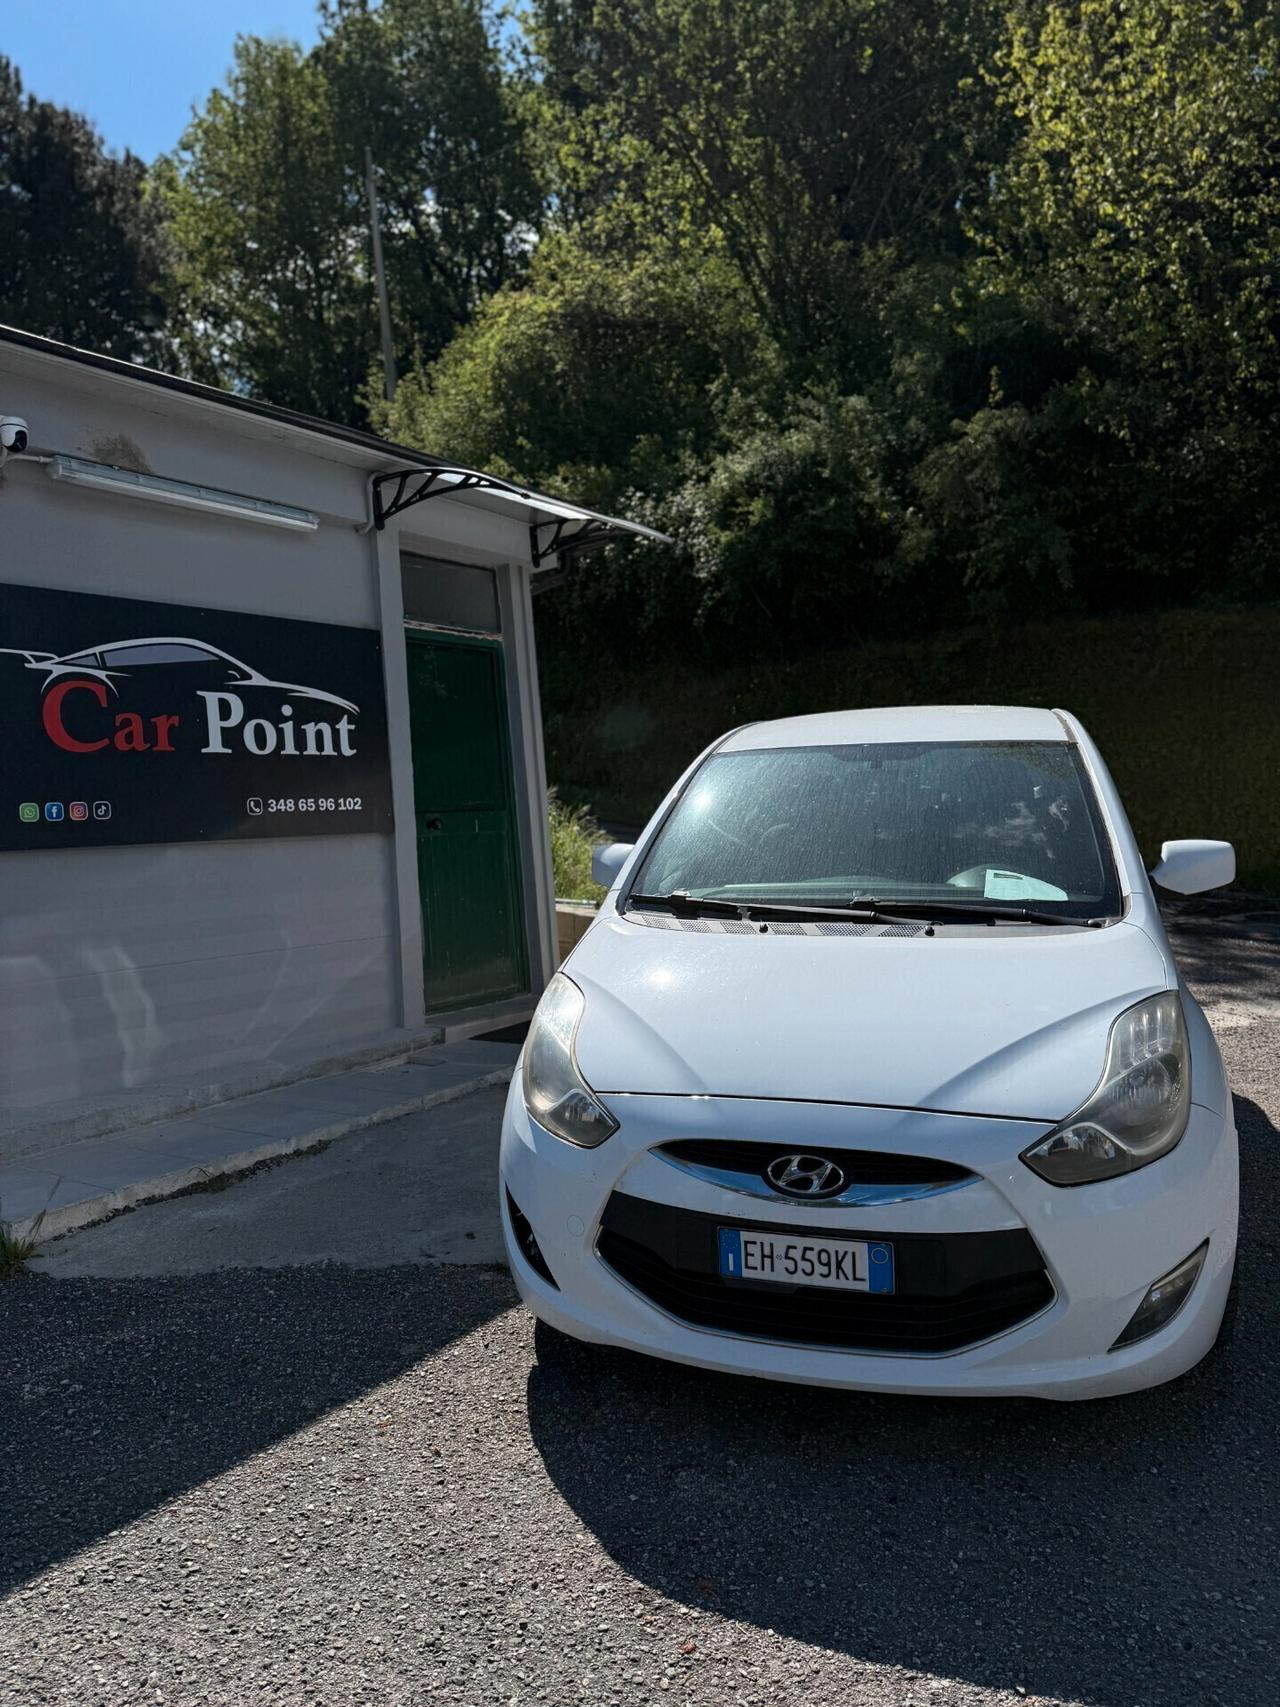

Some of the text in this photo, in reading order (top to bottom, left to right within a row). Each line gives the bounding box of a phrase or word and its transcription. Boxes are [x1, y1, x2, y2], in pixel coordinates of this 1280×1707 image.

[42, 680, 358, 757] Car Point
[267, 797, 362, 812] 348 65 96 102
[743, 1240, 775, 1273] EH
[784, 1245, 867, 1282] 559KL
